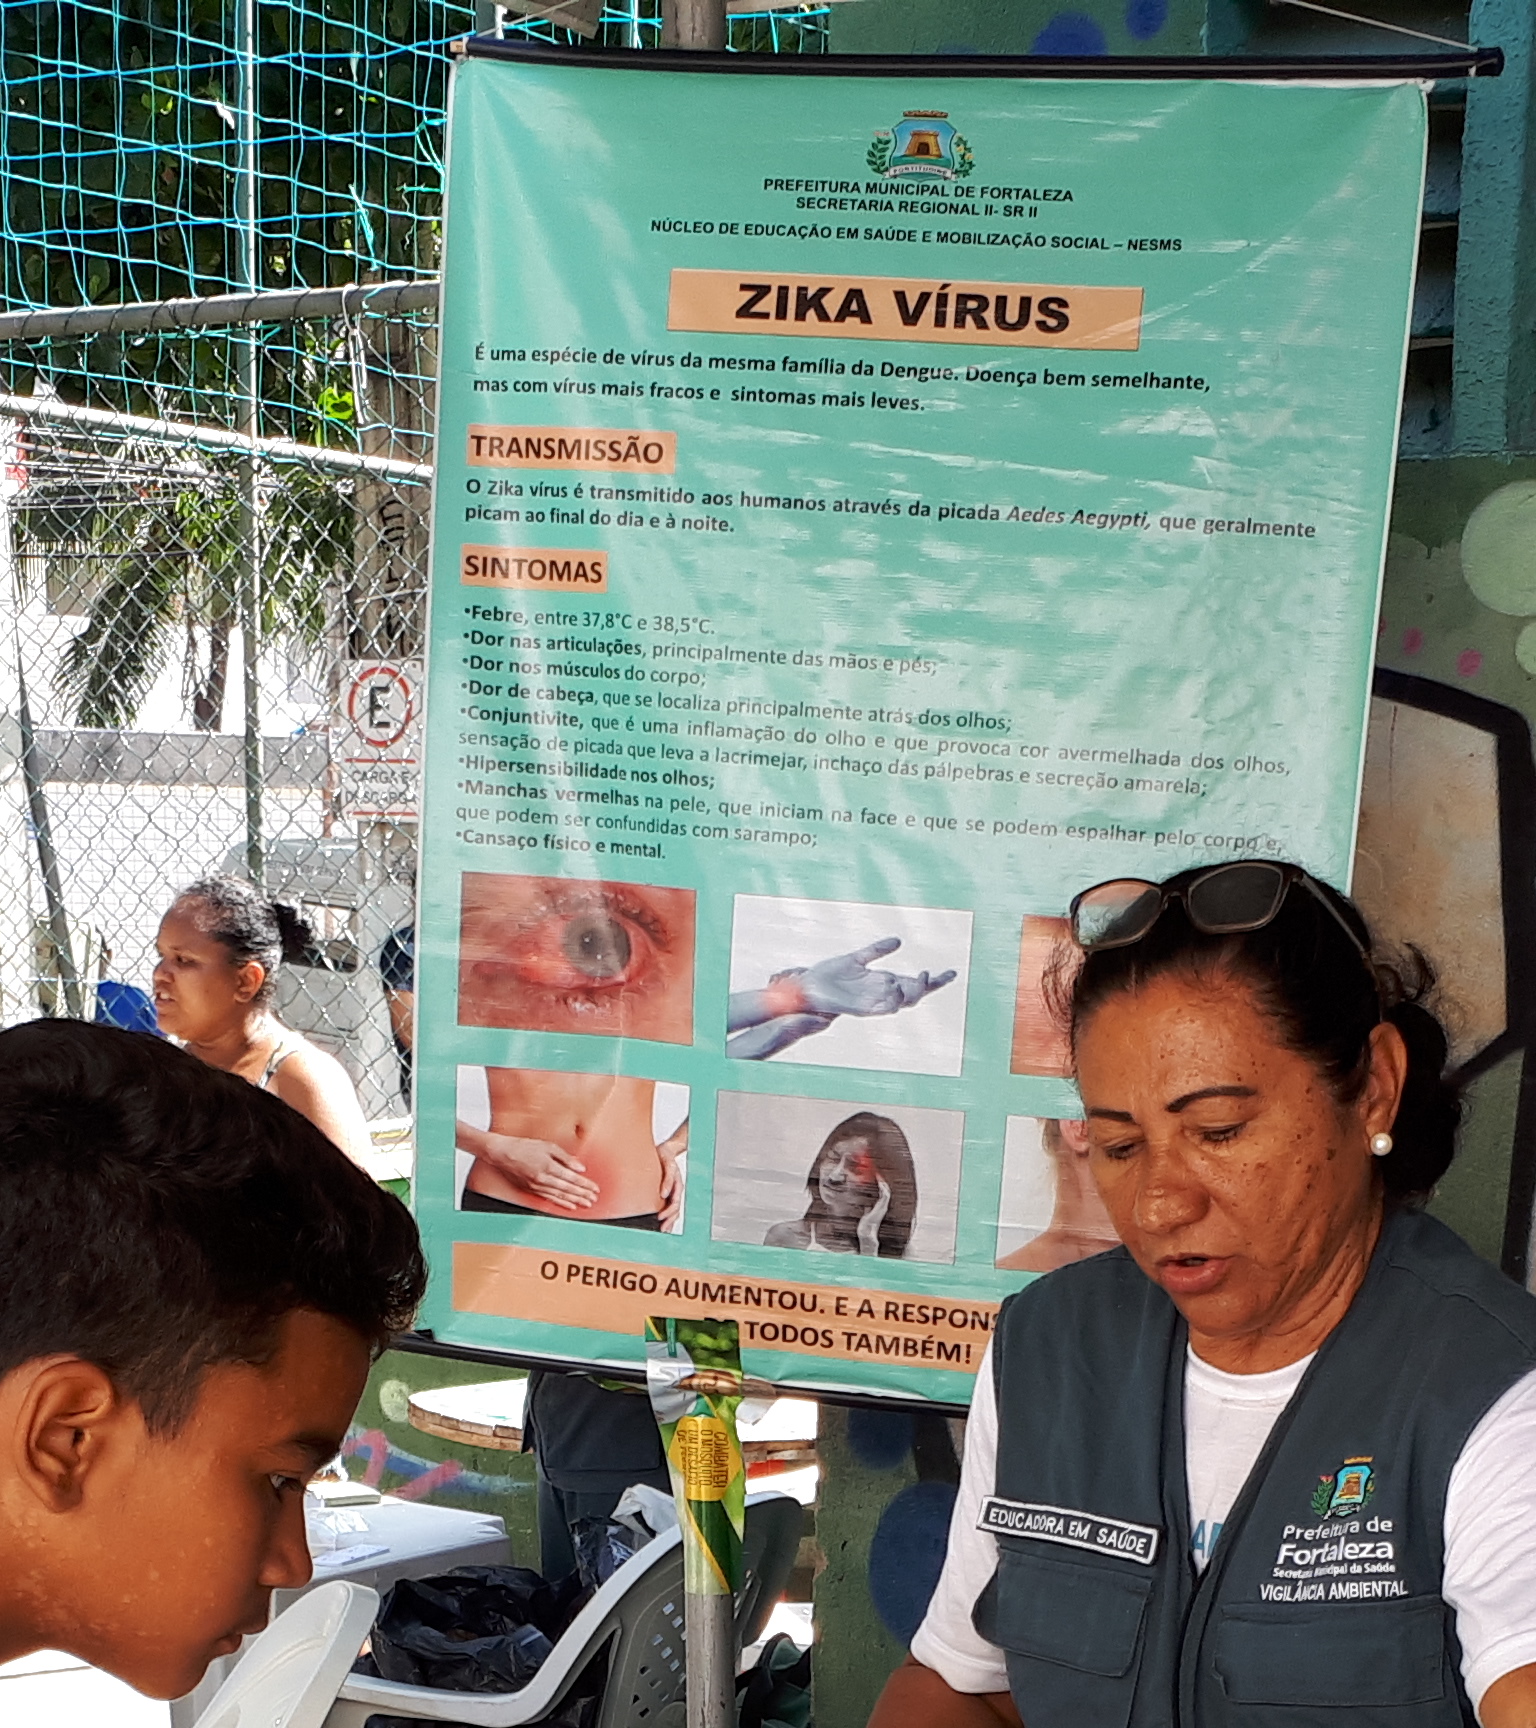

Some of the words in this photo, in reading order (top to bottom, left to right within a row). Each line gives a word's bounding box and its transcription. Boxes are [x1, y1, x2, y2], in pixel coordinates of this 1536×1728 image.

[763, 177, 861, 193] PREFEITURA
[864, 180, 949, 197] MUNICIPAL
[953, 185, 975, 198] DE
[979, 185, 1073, 202] FORTALEZA
[795, 196, 894, 212] SECRETARIA
[897, 199, 980, 215] REGIONAL
[984, 203, 998, 216] II-
[1002, 204, 1024, 217] SR
[1028, 205, 1037, 218] II
[650, 216, 714, 233] NÚCLEO
[718, 221, 739, 235] DE
[743, 223, 832, 240] EDUCAÇÃO
[835, 226, 859, 239] EM
[863, 225, 917, 242] SAÚDE
[921, 230, 932, 243] E
[935, 230, 1046, 248] MOBILIZAÇÃO
[1050, 235, 1110, 250] SOCIAL
[1126, 237, 1182, 251] NESMS
[734, 283, 872, 325] ZIKA
[892, 282, 1069, 333] VÍRUS
[474, 341, 484, 360] É
[490, 348, 526, 361] uma
[530, 346, 597, 365] espécie
[602, 347, 625, 365] de
[630, 349, 674, 367] vírus
[679, 351, 702, 368] da
[708, 356, 775, 371] mesma
[781, 355, 845, 375] família
[850, 358, 874, 376] da
[880, 361, 958, 383] Dengue.
[965, 368, 1037, 387] Doença
[1042, 367, 1085, 386] bem
[1090, 371, 1210, 392] semelhante,
[472, 379, 508, 392] mas
[512, 379, 548, 393] com
[552, 377, 596, 394] vírus
[601, 380, 644, 397] mais
[649, 381, 704, 399] fracos
[709, 388, 720, 400] e
[730, 385, 815, 405] sintomas
[821, 390, 865, 407] mais
[870, 390, 924, 410] leves.
[469, 434, 663, 464] TRANSMISSÃO
[463, 554, 602, 583] SINTOMAS
[369, 686, 390, 728] E
[540, 1260, 559, 1280] O
[566, 1263, 657, 1294] PERIGO
[663, 1277, 825, 1314] AUMENTOU.
[834, 1295, 848, 1316] E
[855, 1298, 875, 1319] A
[743, 1320, 834, 1348] TODOS
[841, 1331, 971, 1364] TAMBÉM!
[988, 1507, 1064, 1534] EDUCADORA
[1067, 1520, 1091, 1539] EM
[1095, 1527, 1146, 1556] SAÚDE
[1282, 1520, 1359, 1540] Prefeitura
[1366, 1517, 1392, 1533] de
[1277, 1537, 1393, 1565] Fortaleza
[1260, 1580, 1325, 1602] VIGILÂNCIA
[1328, 1579, 1408, 1600] AMBIENTAL
